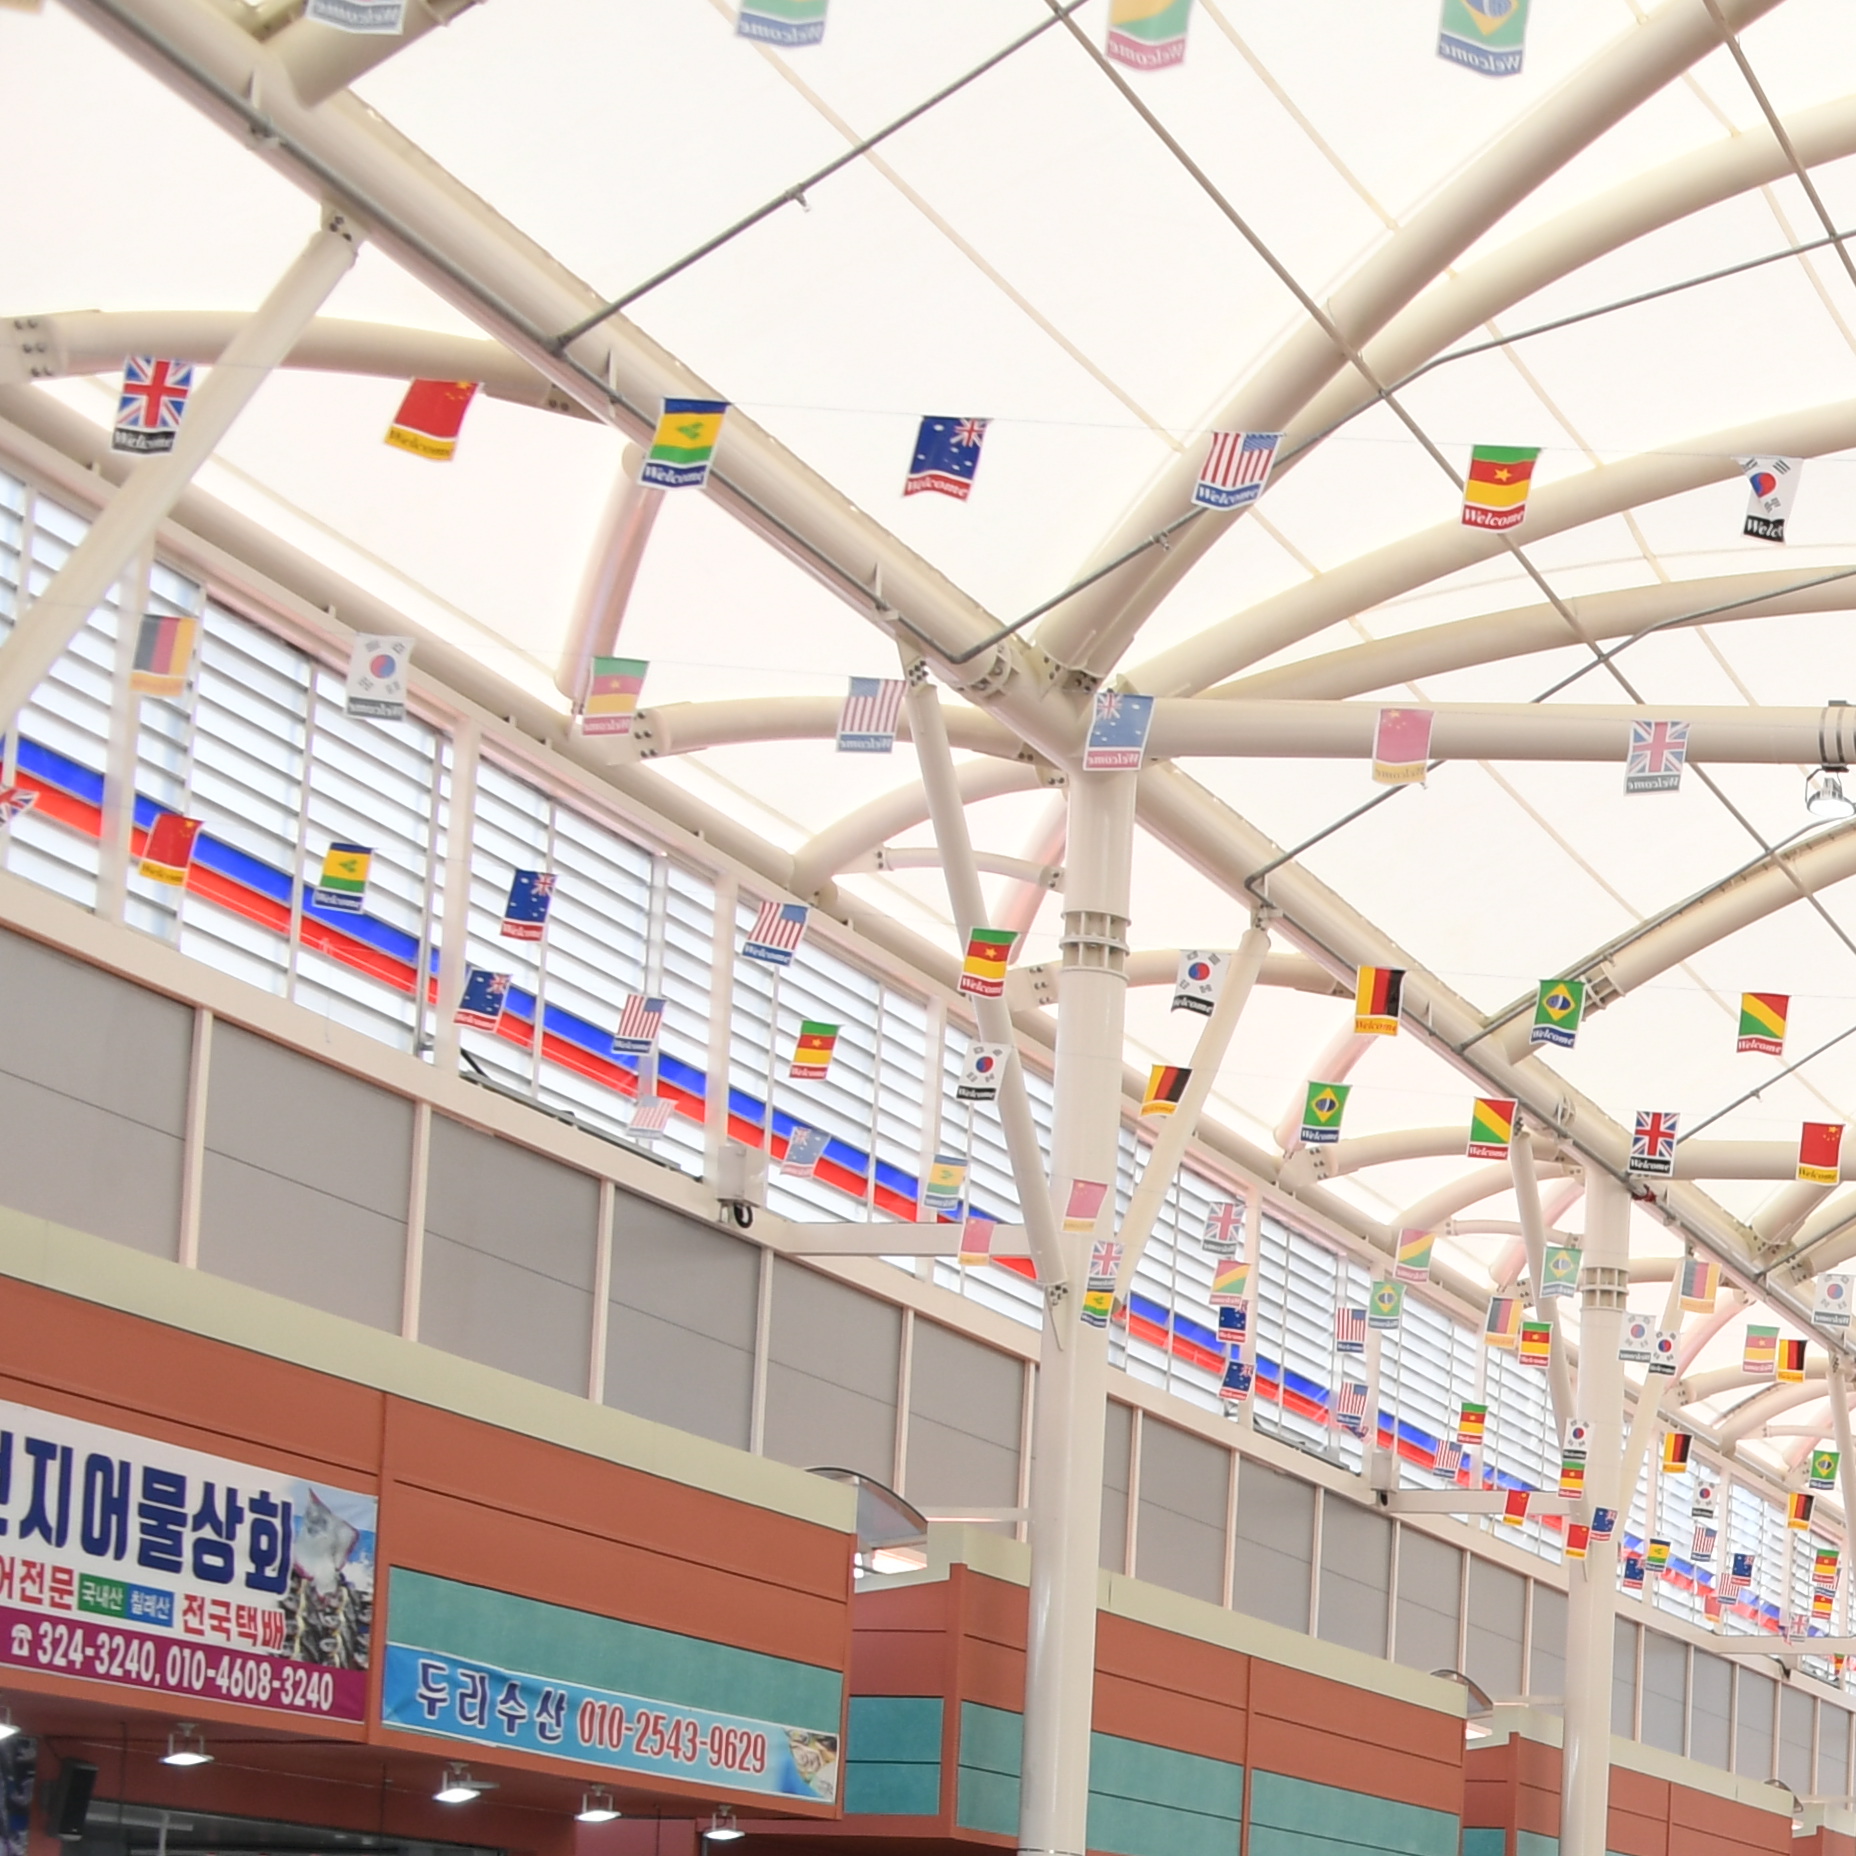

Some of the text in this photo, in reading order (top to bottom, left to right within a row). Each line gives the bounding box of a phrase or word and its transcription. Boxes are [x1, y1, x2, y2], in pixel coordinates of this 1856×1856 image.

[80, 1577, 125, 1611] 국내산
[181, 1593, 285, 1651] 전국택배
[165, 1645, 334, 1711] 010-4608-3240
[417, 1657, 767, 1775] 두리수산 010-2543-9629
